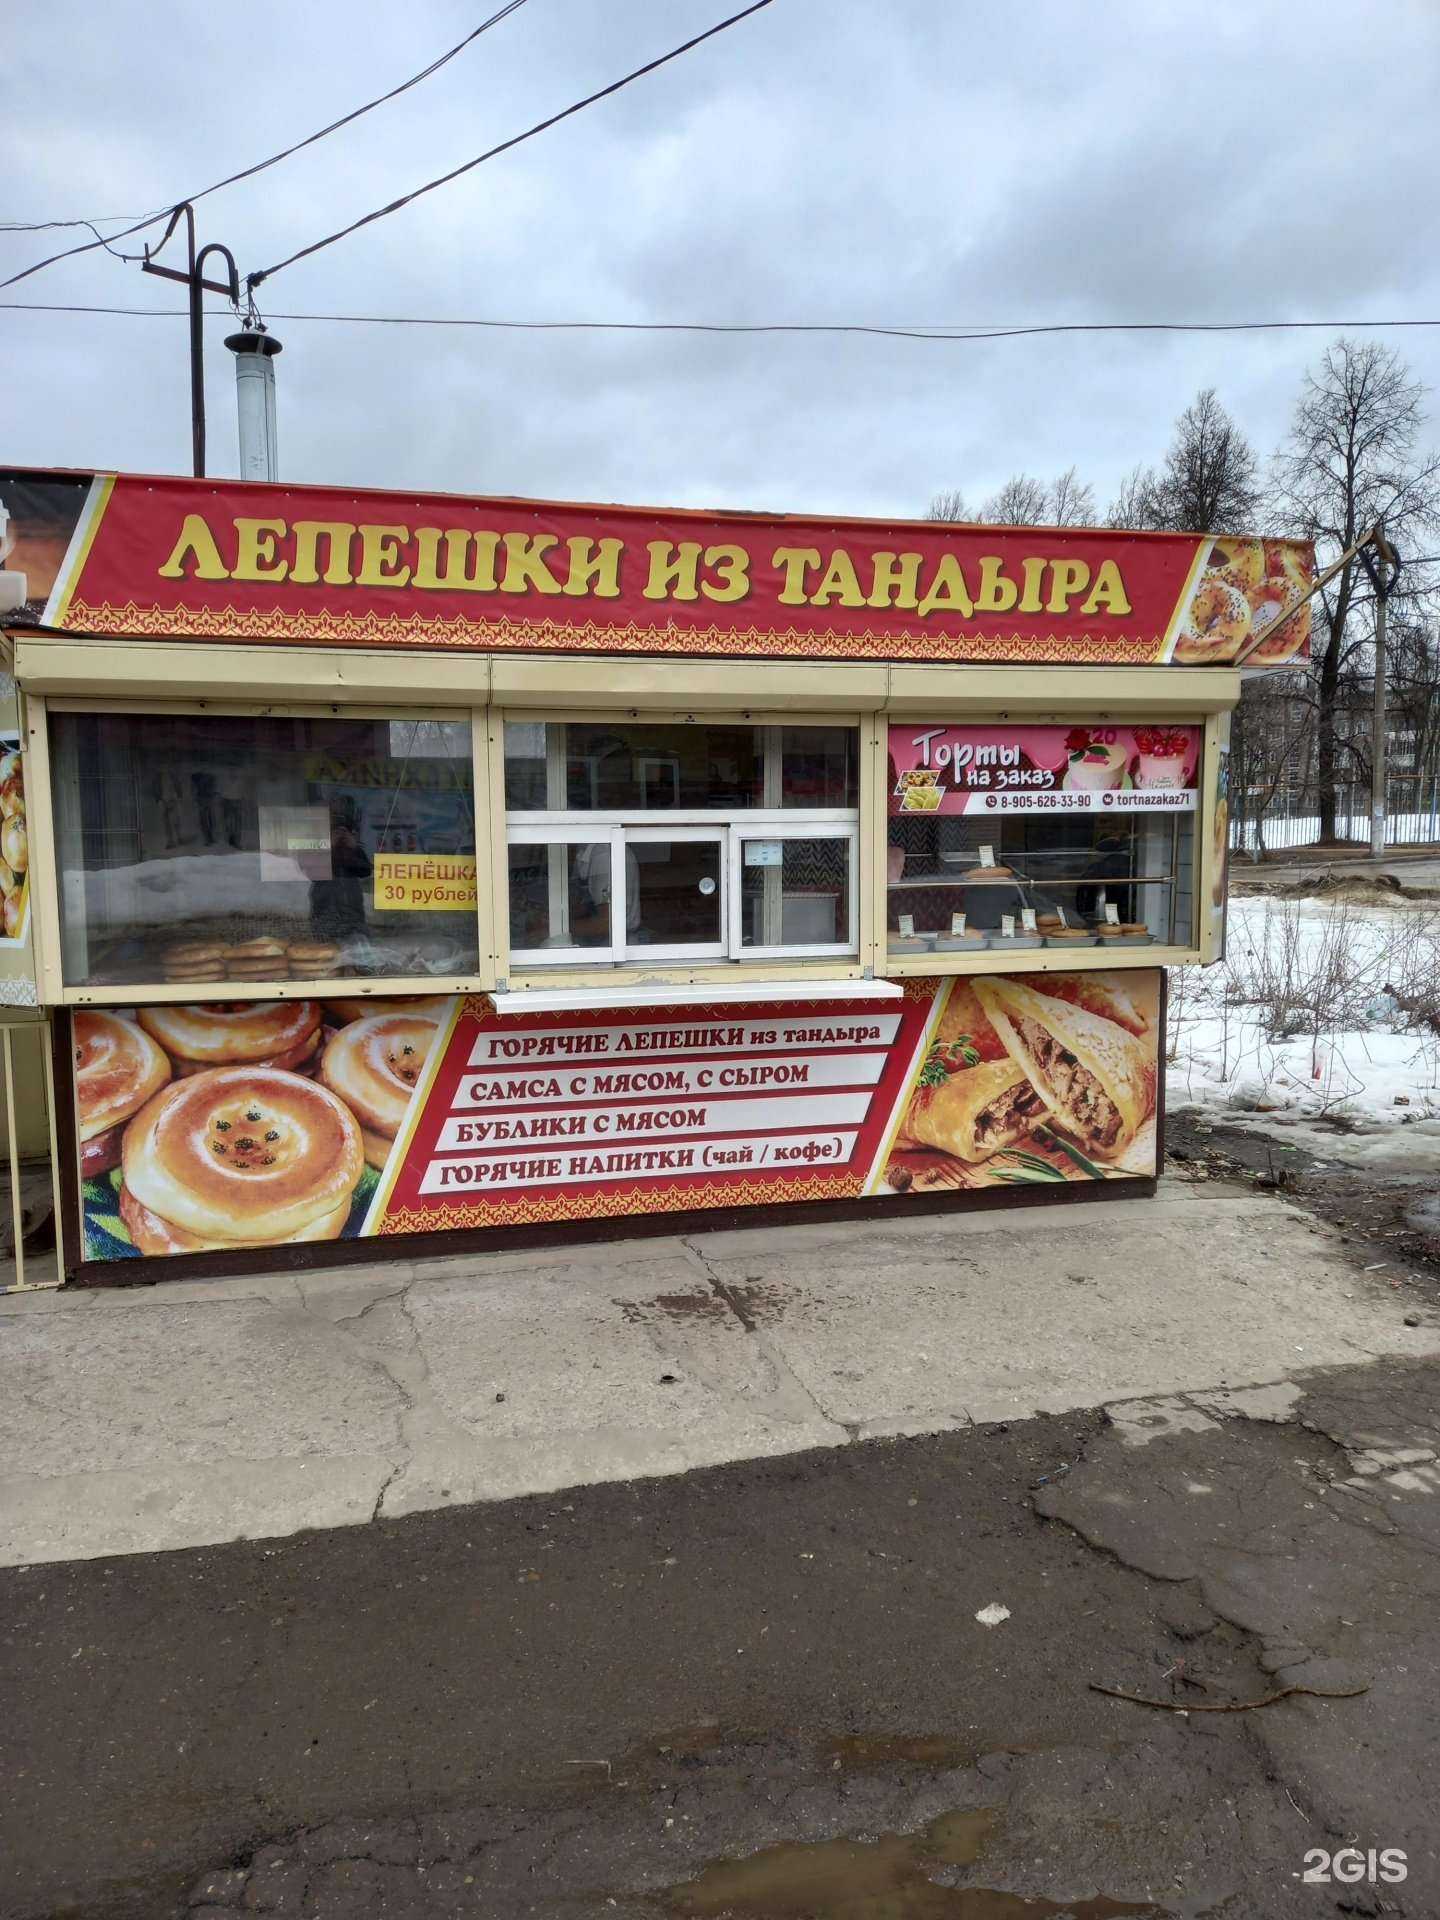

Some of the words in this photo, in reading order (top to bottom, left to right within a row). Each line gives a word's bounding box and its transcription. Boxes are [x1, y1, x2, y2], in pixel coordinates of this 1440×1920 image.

[157, 513, 625, 598] ЛЕПЕШКИ
[642, 540, 751, 602] ИЗ
[771, 545, 1133, 617] ТАНДЫРА
[912, 728, 1021, 784] Торты
[966, 769, 990, 786] на
[994, 767, 1055, 789] заказ
[1000, 793, 1091, 809] 8-905-626-33-90
[1117, 792, 1190, 806] tortnazakaz71
[384, 885, 405, 900] 30
[488, 1033, 609, 1058] ГОРЯЧИЕ
[615, 1028, 744, 1053] ЛЕПЕШКИ
[750, 1028, 778, 1044] из
[783, 1024, 881, 1044] тандыра
[469, 1078, 563, 1101] САМСА
[570, 1076, 586, 1095] С
[592, 1071, 690, 1094] МЯСОМ,
[697, 1069, 713, 1088] С
[719, 1064, 810, 1087] СЫРОМ
[456, 1116, 587, 1143] БУБЛИКИ
[593, 1115, 610, 1134] С
[616, 1109, 707, 1132] МЯСОМ
[440, 1158, 562, 1186] ГОРЯЧИЕ
[569, 1149, 694, 1173] НАПИТКИ
[702, 1145, 753, 1168] (чай
[759, 1144, 770, 1164] /
[774, 1137, 844, 1162] кофе)
